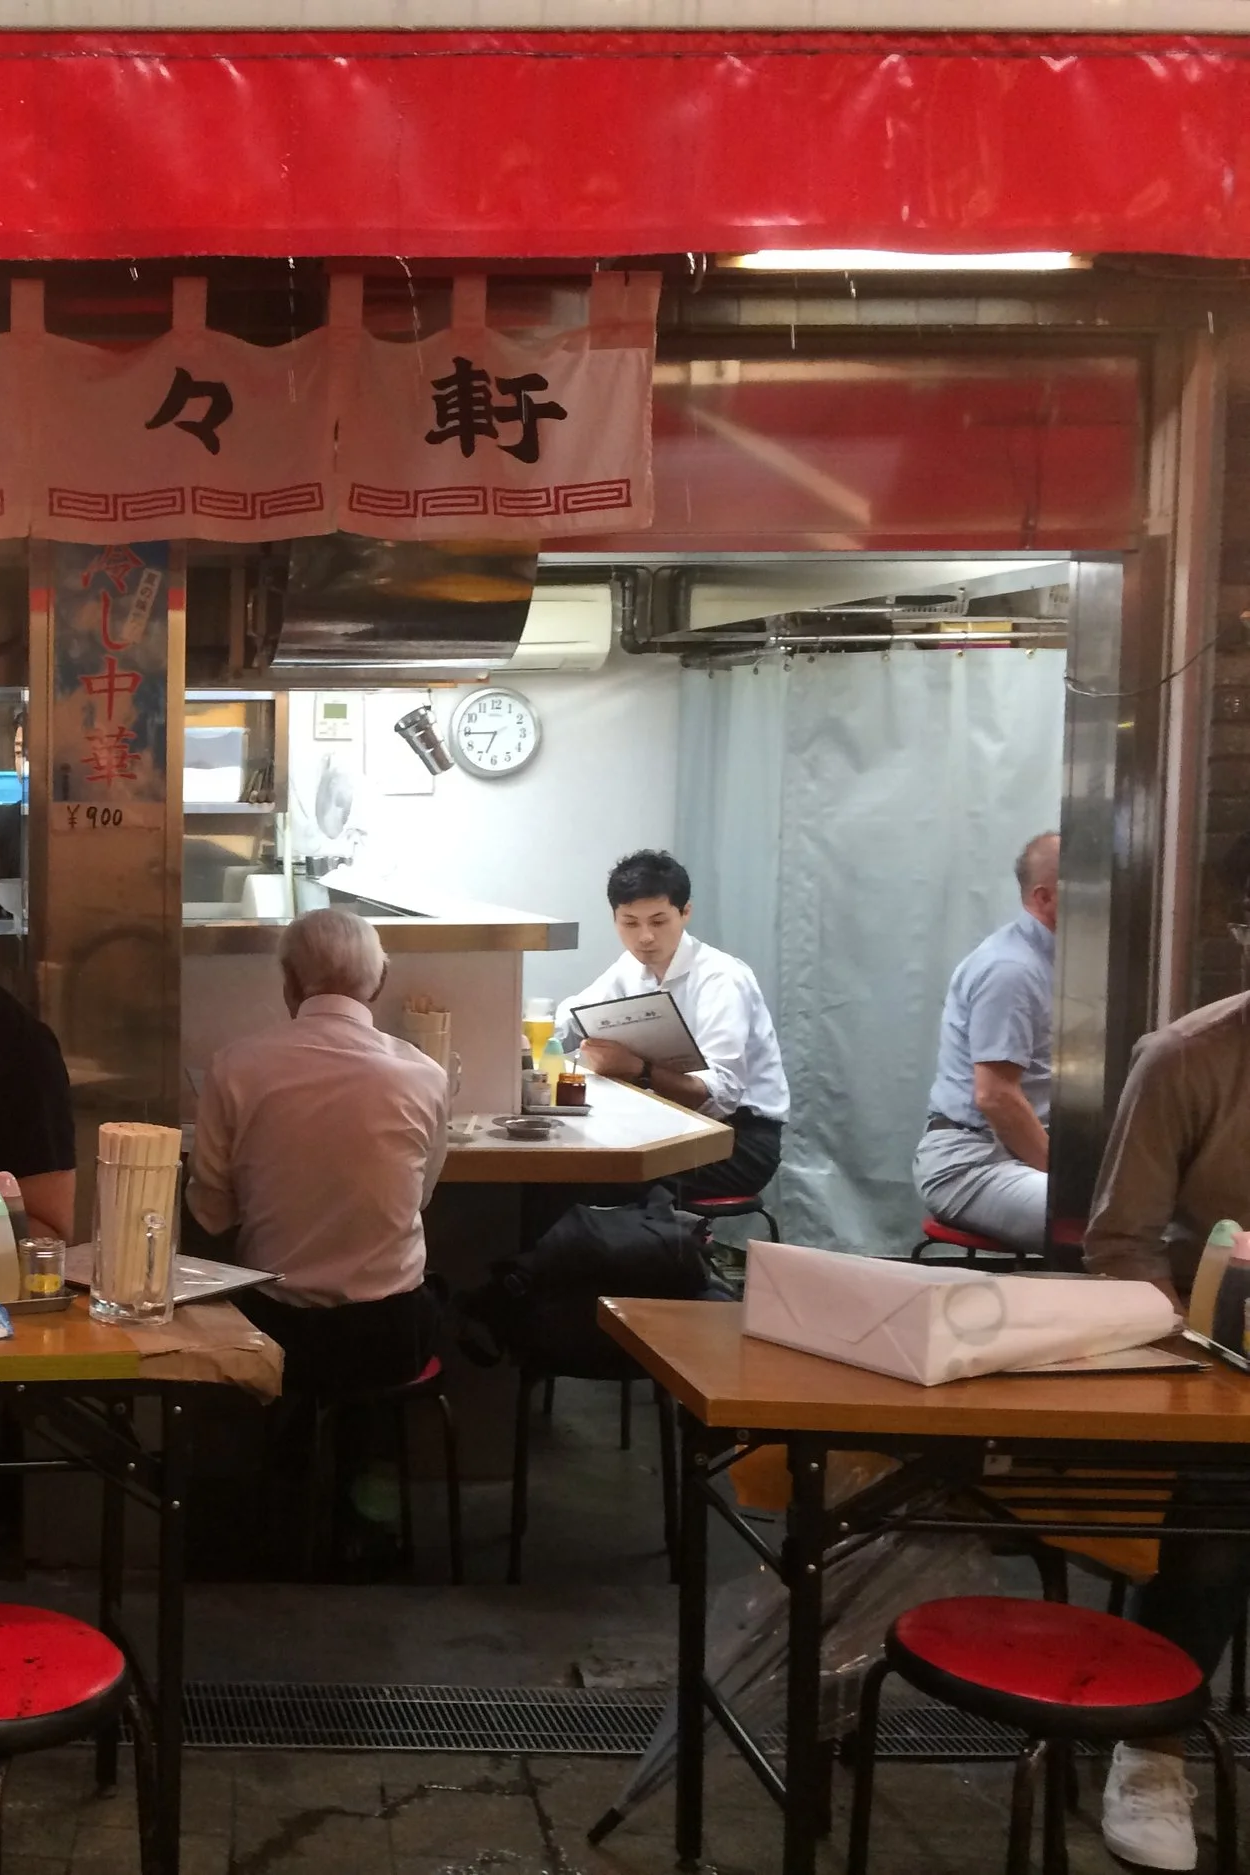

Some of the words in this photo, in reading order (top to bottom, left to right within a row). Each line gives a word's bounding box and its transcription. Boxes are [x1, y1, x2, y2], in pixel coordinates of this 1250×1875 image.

[79, 544, 144, 789] 冷し中華
[490, 699, 503, 710] 12
[516, 714, 524, 725] 2
[519, 728, 527, 739] 3
[66, 804, 124, 829] ¥900
